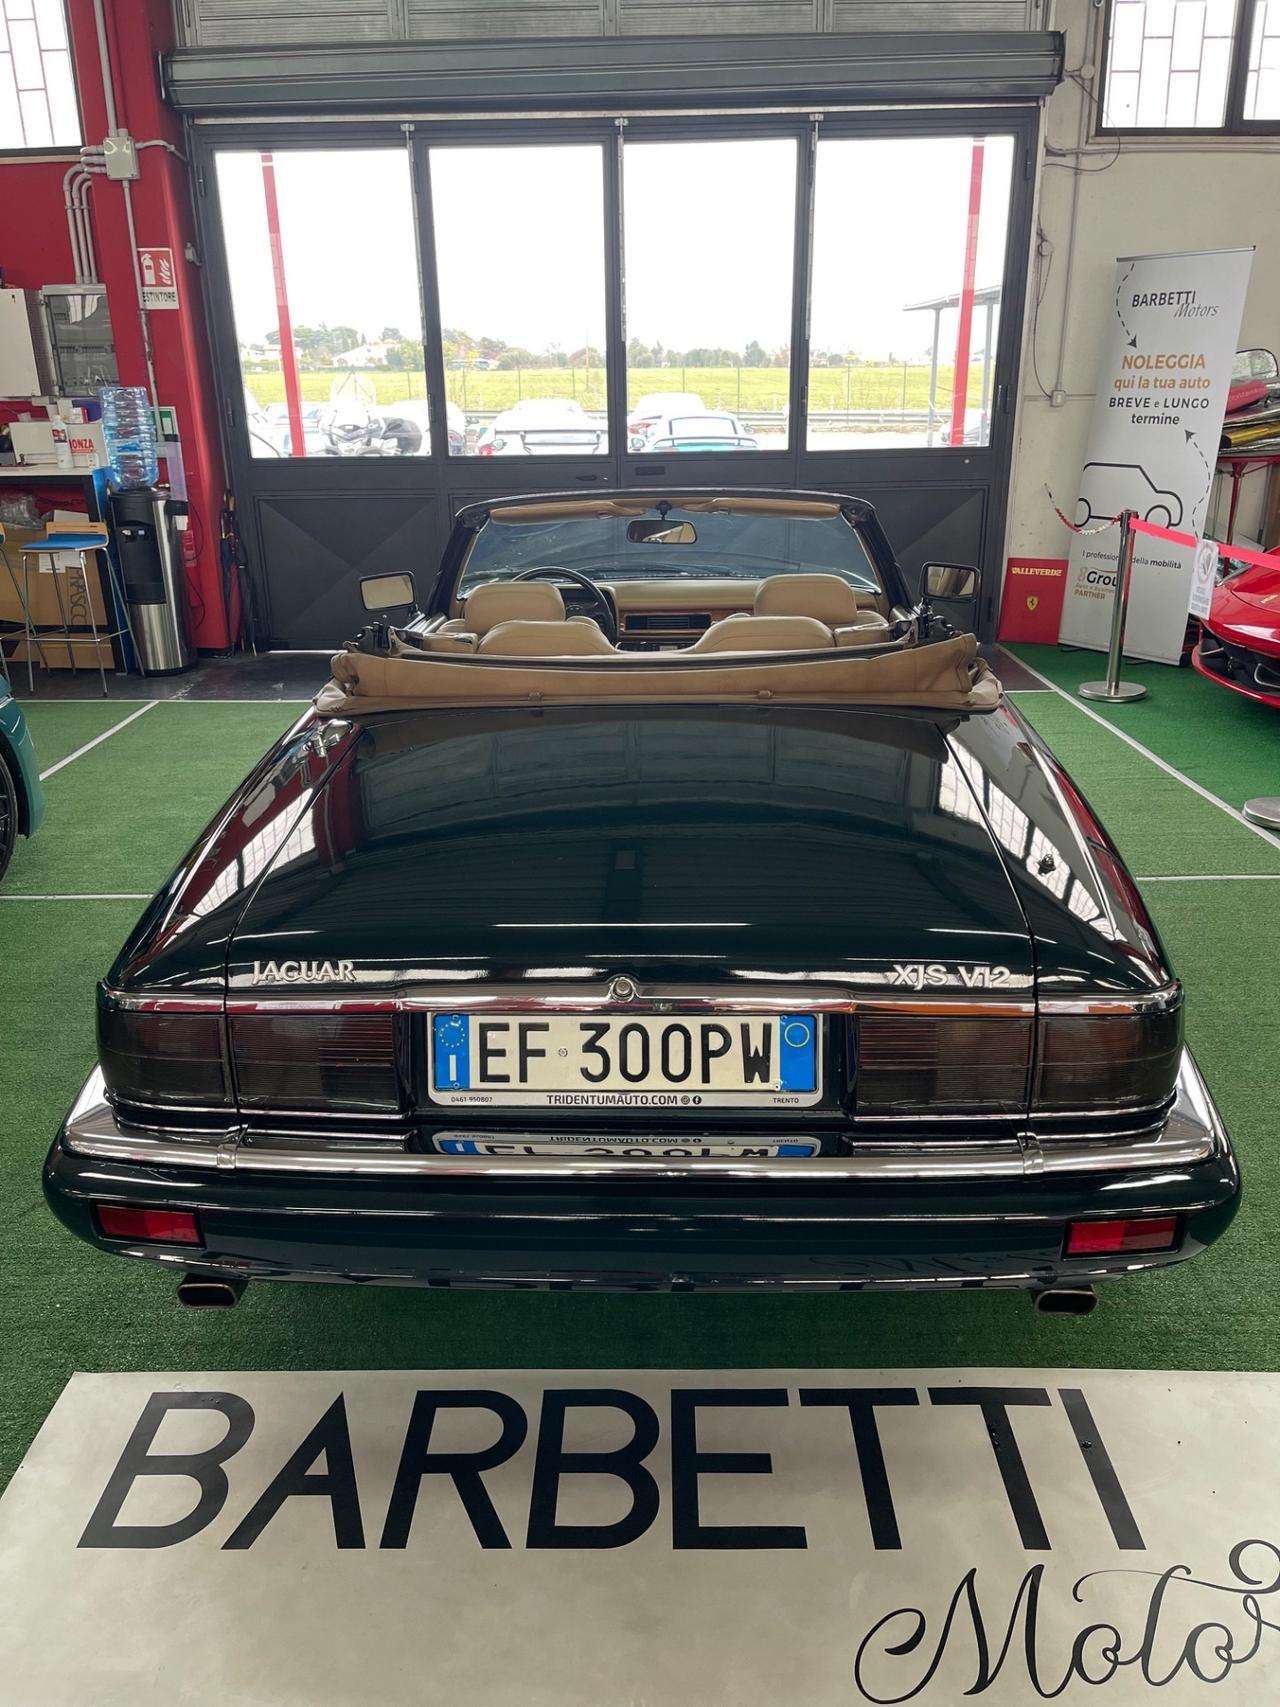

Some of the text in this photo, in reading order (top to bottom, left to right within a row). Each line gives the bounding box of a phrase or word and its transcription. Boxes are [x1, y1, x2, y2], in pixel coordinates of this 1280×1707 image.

[142, 291, 177, 303] ESTINTORE
[1132, 290, 1196, 307] BARBETTI
[1174, 303, 1219, 318] Motors
[1121, 353, 1206, 370] NOLEGGIA
[1114, 375, 1211, 392] qui la tua auto
[1108, 397, 1209, 409] BREVE e LUNGO
[1131, 412, 1180, 425] termine
[1086, 551, 1119, 561] profession
[1150, 559, 1182, 569] mobilità
[1073, 589, 1106, 600] PARTNER
[252, 960, 357, 985] JAGUAR
[893, 964, 1011, 990] XJS V12
[479, 1022, 550, 1083] EF
[580, 1022, 772, 1084] 300PW
[546, 1095, 678, 1105] TRIDENTUMAUTO.COM
[77, 1388, 1146, 1550] BARBETTI
